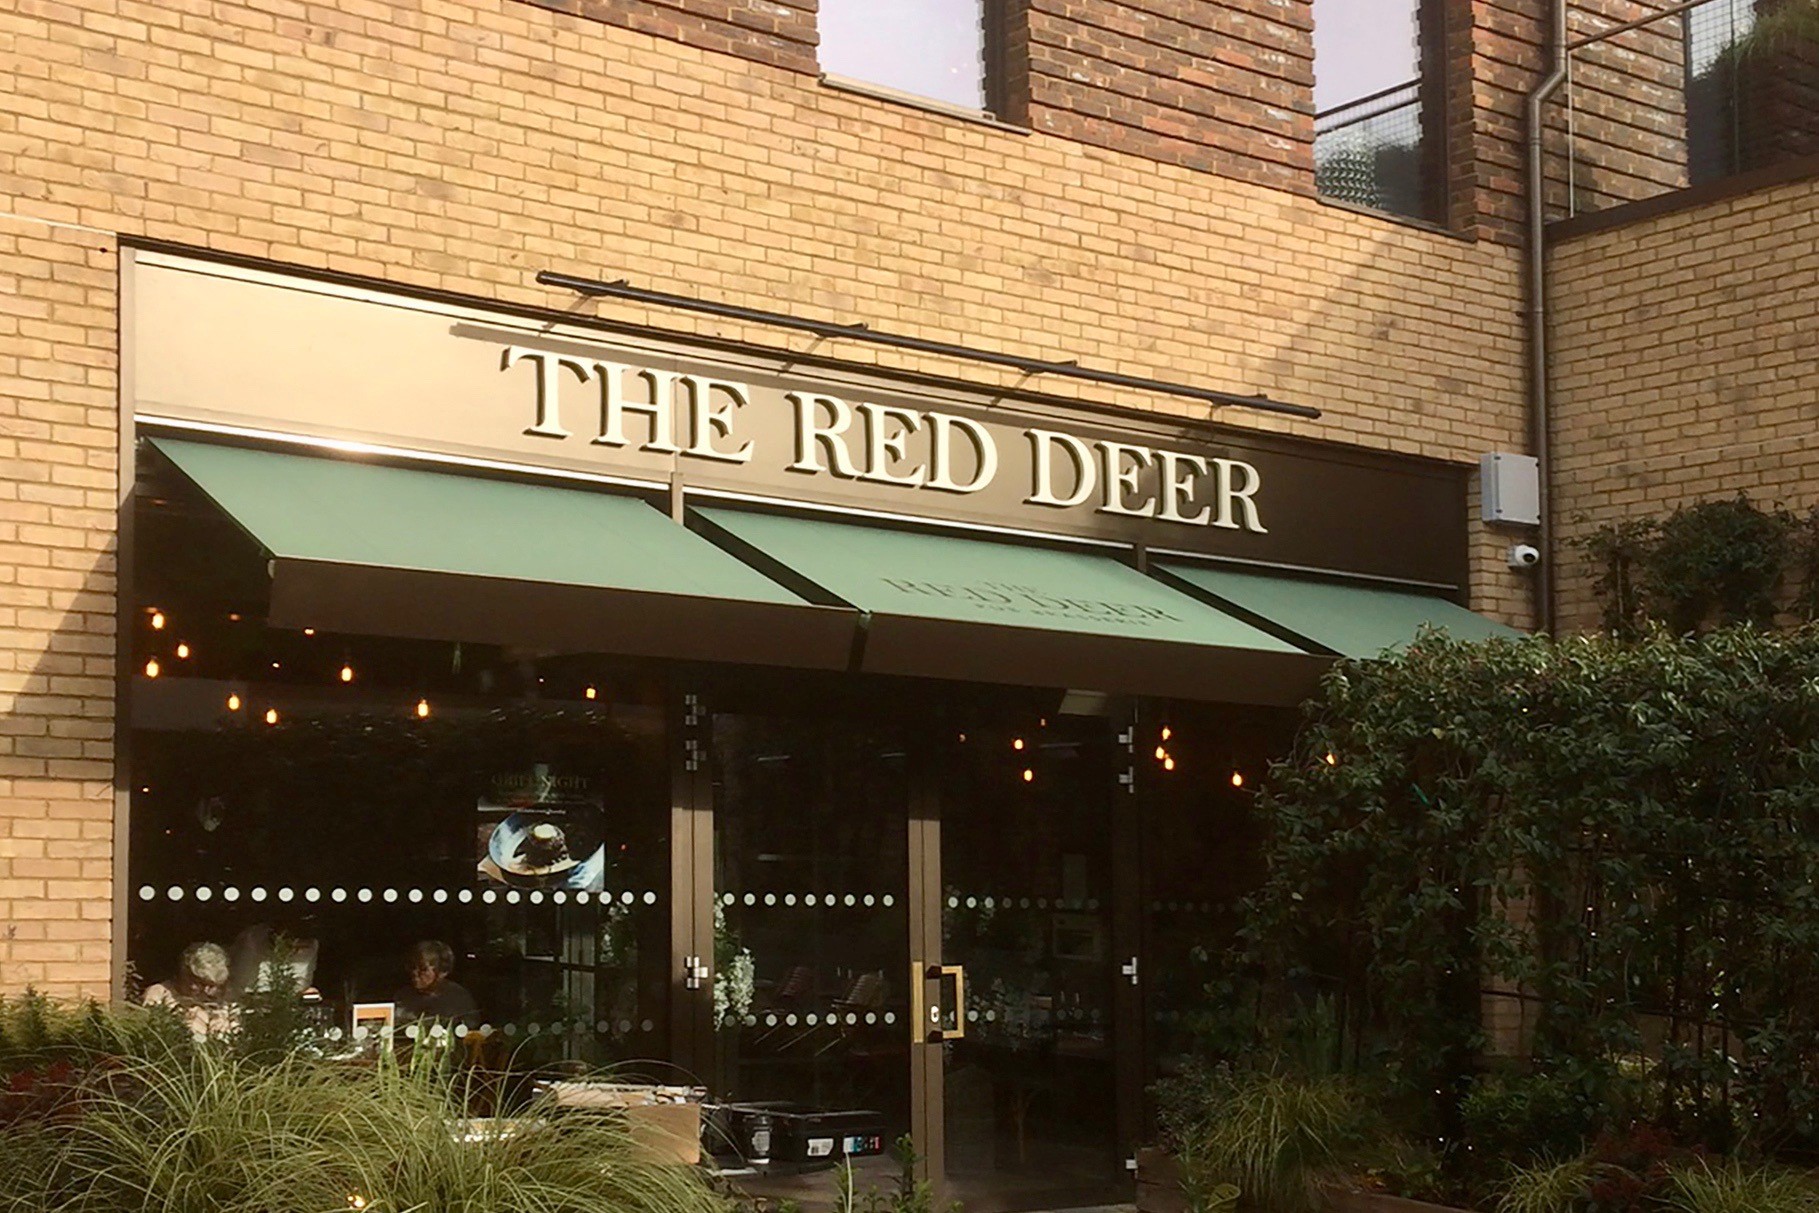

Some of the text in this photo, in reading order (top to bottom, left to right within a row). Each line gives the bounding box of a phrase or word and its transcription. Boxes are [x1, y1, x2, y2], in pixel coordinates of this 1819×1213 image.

[502, 345, 1269, 534] THE RED DEER
[880, 577, 1013, 603] RED
[1017, 592, 1183, 622] DEER
